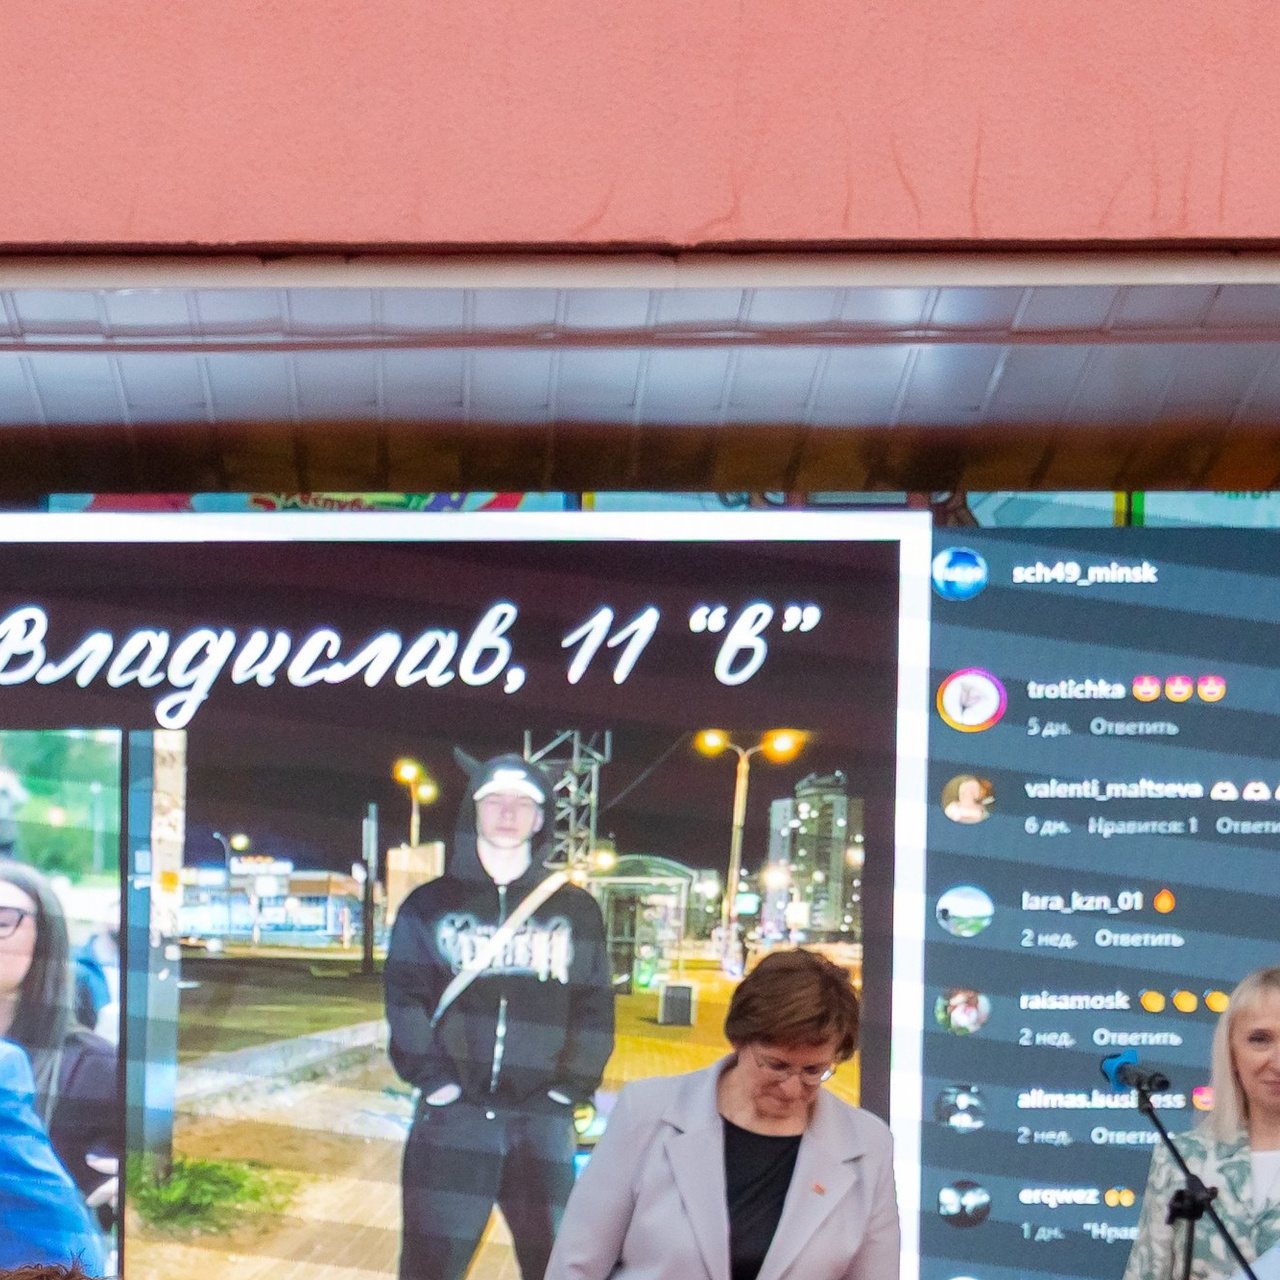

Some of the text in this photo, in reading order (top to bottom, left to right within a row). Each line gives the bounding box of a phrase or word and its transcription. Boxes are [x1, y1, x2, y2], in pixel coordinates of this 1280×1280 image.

[1013, 561, 1158, 586] sch49_minsk
[561, 605, 661, 684] 11
[1027, 679, 1126, 700] trotichka
[1027, 716, 1040, 736] 5
[1090, 716, 1179, 736] Ответить
[1024, 816, 1039, 835] 6
[1022, 891, 1144, 914] lara_kzn_01
[1021, 929, 1036, 948] 2
[1094, 929, 1185, 948] Ответить
[1020, 990, 1131, 1010] raisamosk
[1019, 1028, 1034, 1047] 2
[1092, 1028, 1183, 1047] Ответить
[1017, 1126, 1031, 1145] 2
[1091, 1126, 1176, 1145] Ответи
